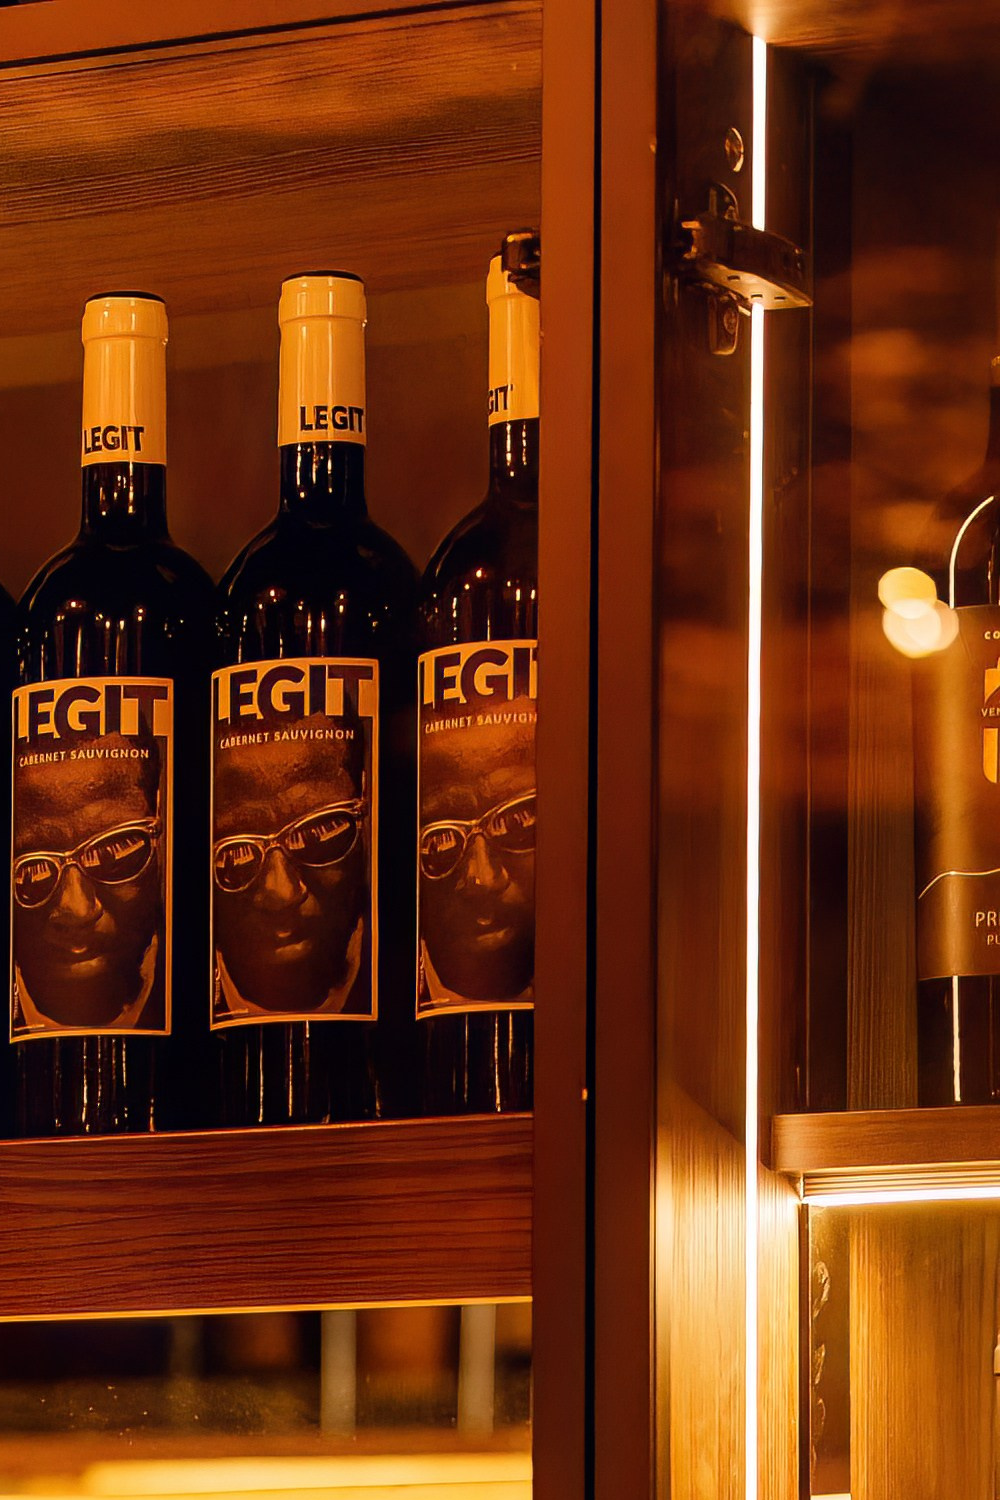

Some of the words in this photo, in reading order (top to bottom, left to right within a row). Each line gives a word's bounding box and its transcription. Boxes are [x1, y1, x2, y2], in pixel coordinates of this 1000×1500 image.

[300, 405, 364, 433] LEGIT
[83, 425, 145, 455] LEGIT
[420, 647, 538, 711] LEGI
[425, 715, 472, 735] CABERNET
[220, 732, 269, 750] CABERNET
[274, 729, 354, 742] SAUVIGNON
[19, 751, 66, 768] CABERNET
[70, 749, 149, 760] SAUVIGNON
